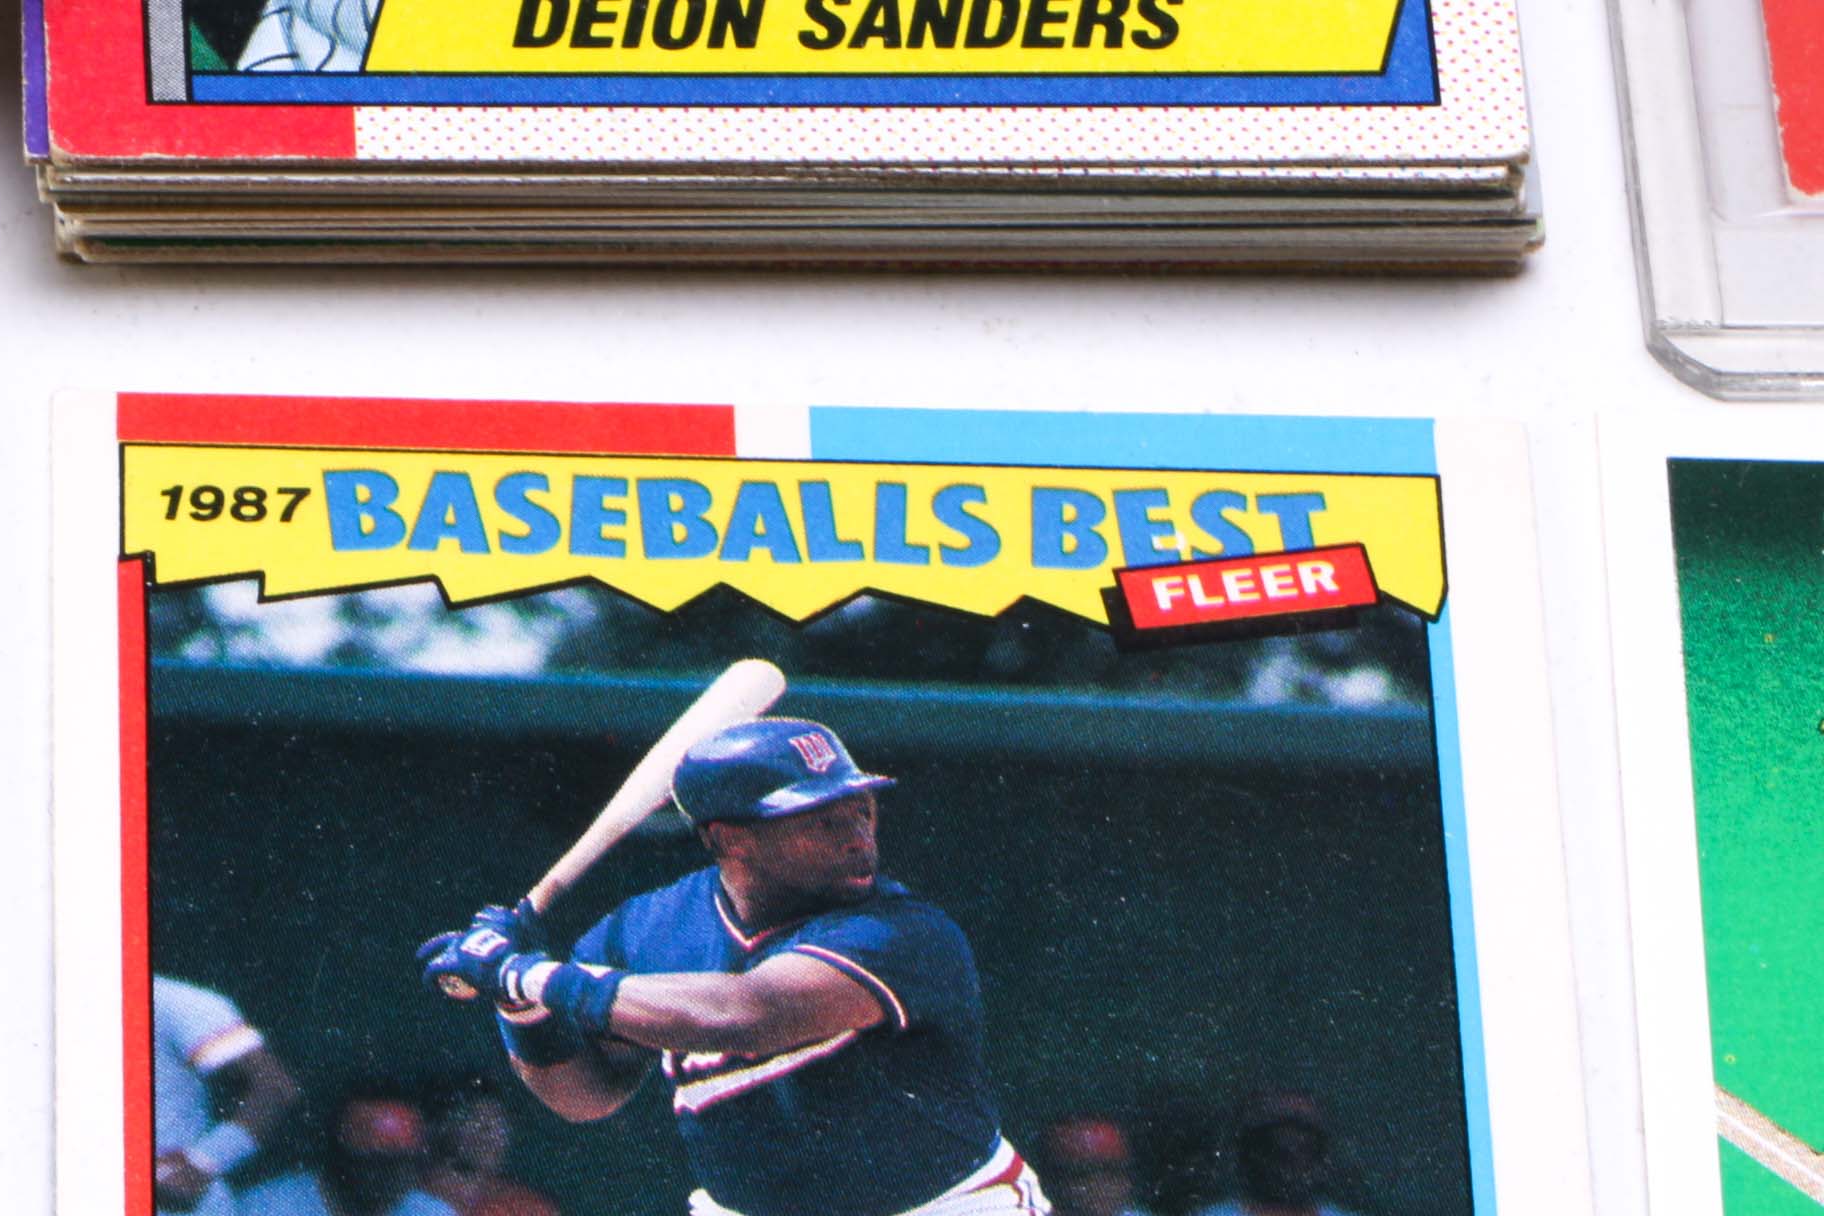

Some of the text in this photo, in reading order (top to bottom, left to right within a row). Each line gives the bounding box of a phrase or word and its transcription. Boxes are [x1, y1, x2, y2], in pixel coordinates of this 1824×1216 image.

[514, 0, 1182, 49] DEION SANDERS
[163, 472, 1323, 568] 1987 BASEBALLS BEST
[1152, 558, 1339, 610] FLEER
